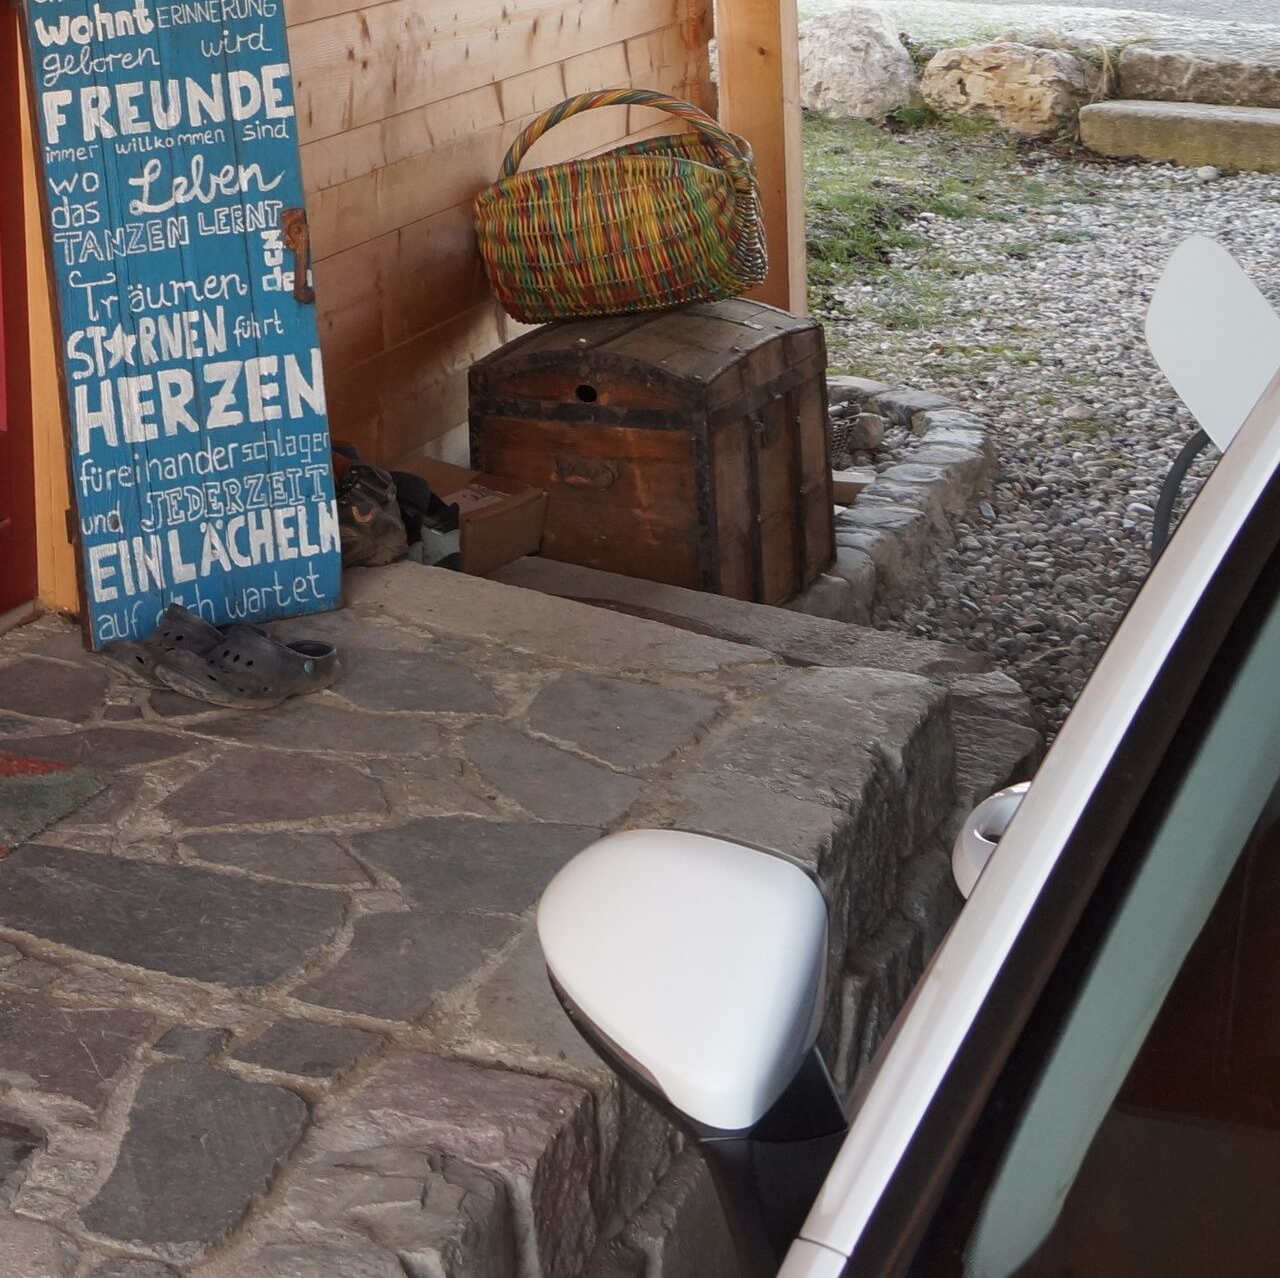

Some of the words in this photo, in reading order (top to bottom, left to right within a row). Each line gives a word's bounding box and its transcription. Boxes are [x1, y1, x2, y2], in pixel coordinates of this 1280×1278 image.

[35, 0, 155, 46] wohnt
[43, 45, 160, 87] geboren
[201, 26, 272, 58] wird
[42, 63, 295, 144] FREUNDE
[45, 144, 99, 164] immer
[115, 127, 226, 154] willkommen
[51, 196, 100, 229] das
[128, 154, 285, 215] Leben
[53, 214, 189, 266] TANZEN
[197, 200, 283, 235] LERNT
[261, 265, 313, 292] de
[232, 309, 284, 348] führt
[74, 348, 326, 455] HERZEN
[80, 436, 238, 497] füreinander
[80, 508, 124, 535] und
[141, 464, 328, 532] JEDERZEIT
[87, 535, 165, 603] EIN
[168, 499, 341, 583] LÄCHELN
[97, 601, 144, 641] auf
[225, 562, 325, 619] wartet
